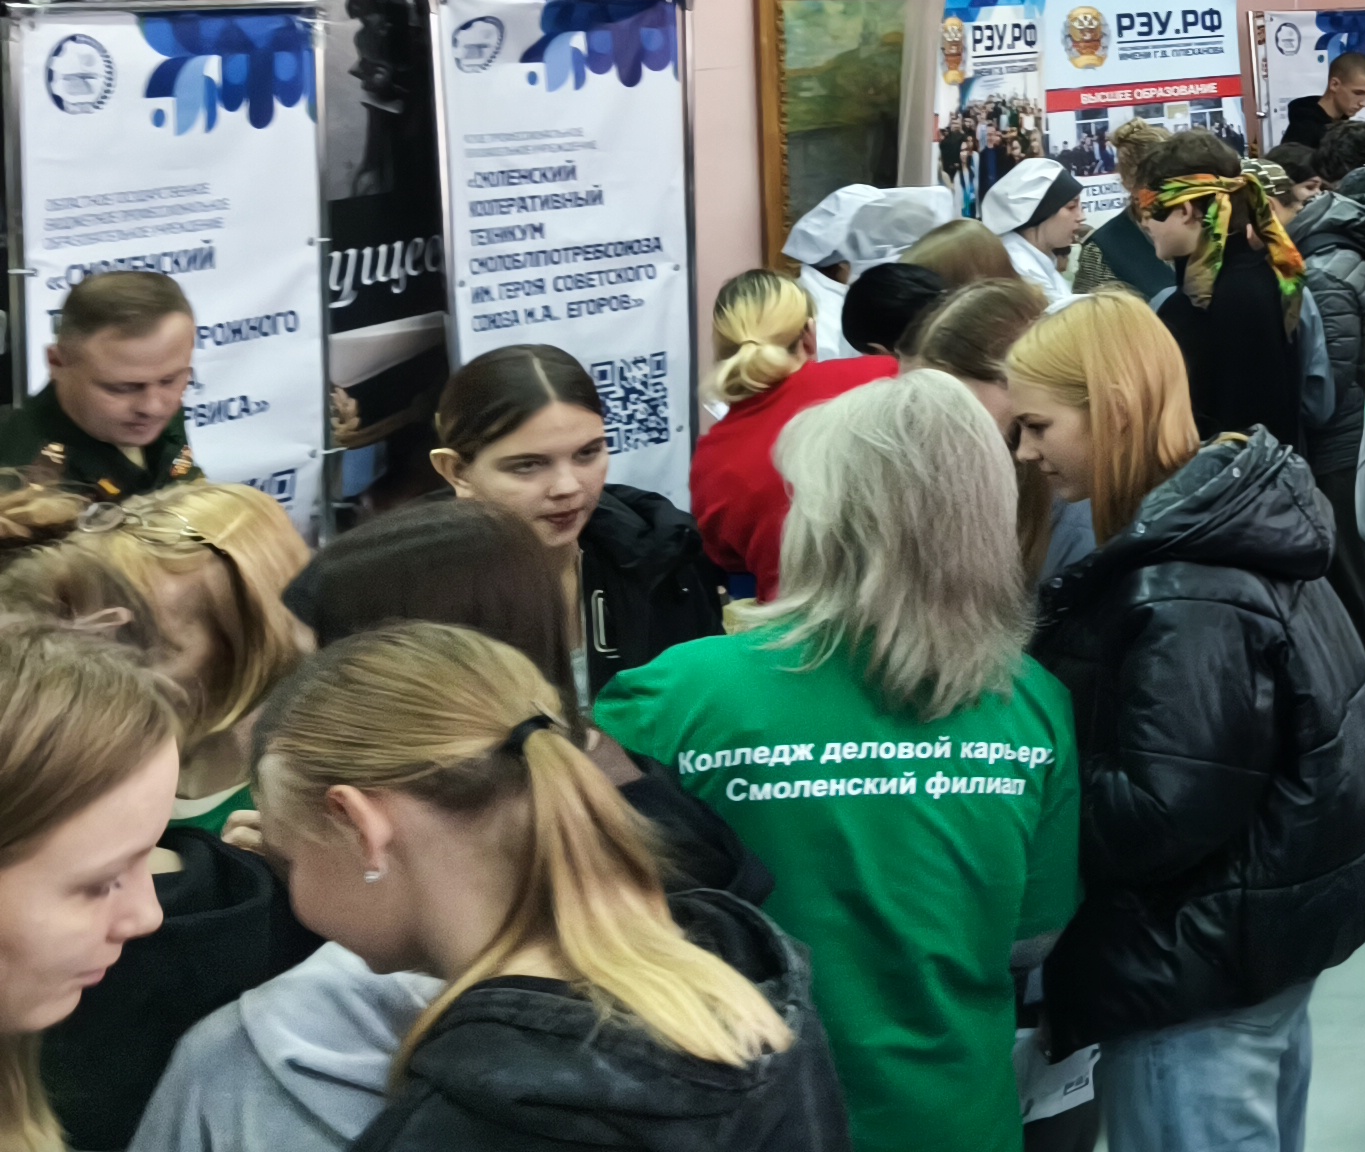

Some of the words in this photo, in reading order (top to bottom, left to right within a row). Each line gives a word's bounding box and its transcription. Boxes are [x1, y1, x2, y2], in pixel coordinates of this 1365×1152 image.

[971, 22, 1038, 52] РЭУ.РФ
[1116, 8, 1223, 37] РЭУ.РФ
[1080, 89, 1133, 105] ВЫСШЕЕ
[1134, 82, 1218, 100] ОБРАЗОВАНИЕ
[552, 263, 657, 293] СОВЕТСКОГО
[566, 293, 645, 319] ЕГОРОВ»
[678, 742, 815, 774] Колледж
[820, 735, 952, 765] деловой
[725, 771, 917, 802] Смоленский
[924, 771, 1026, 800] филиал
